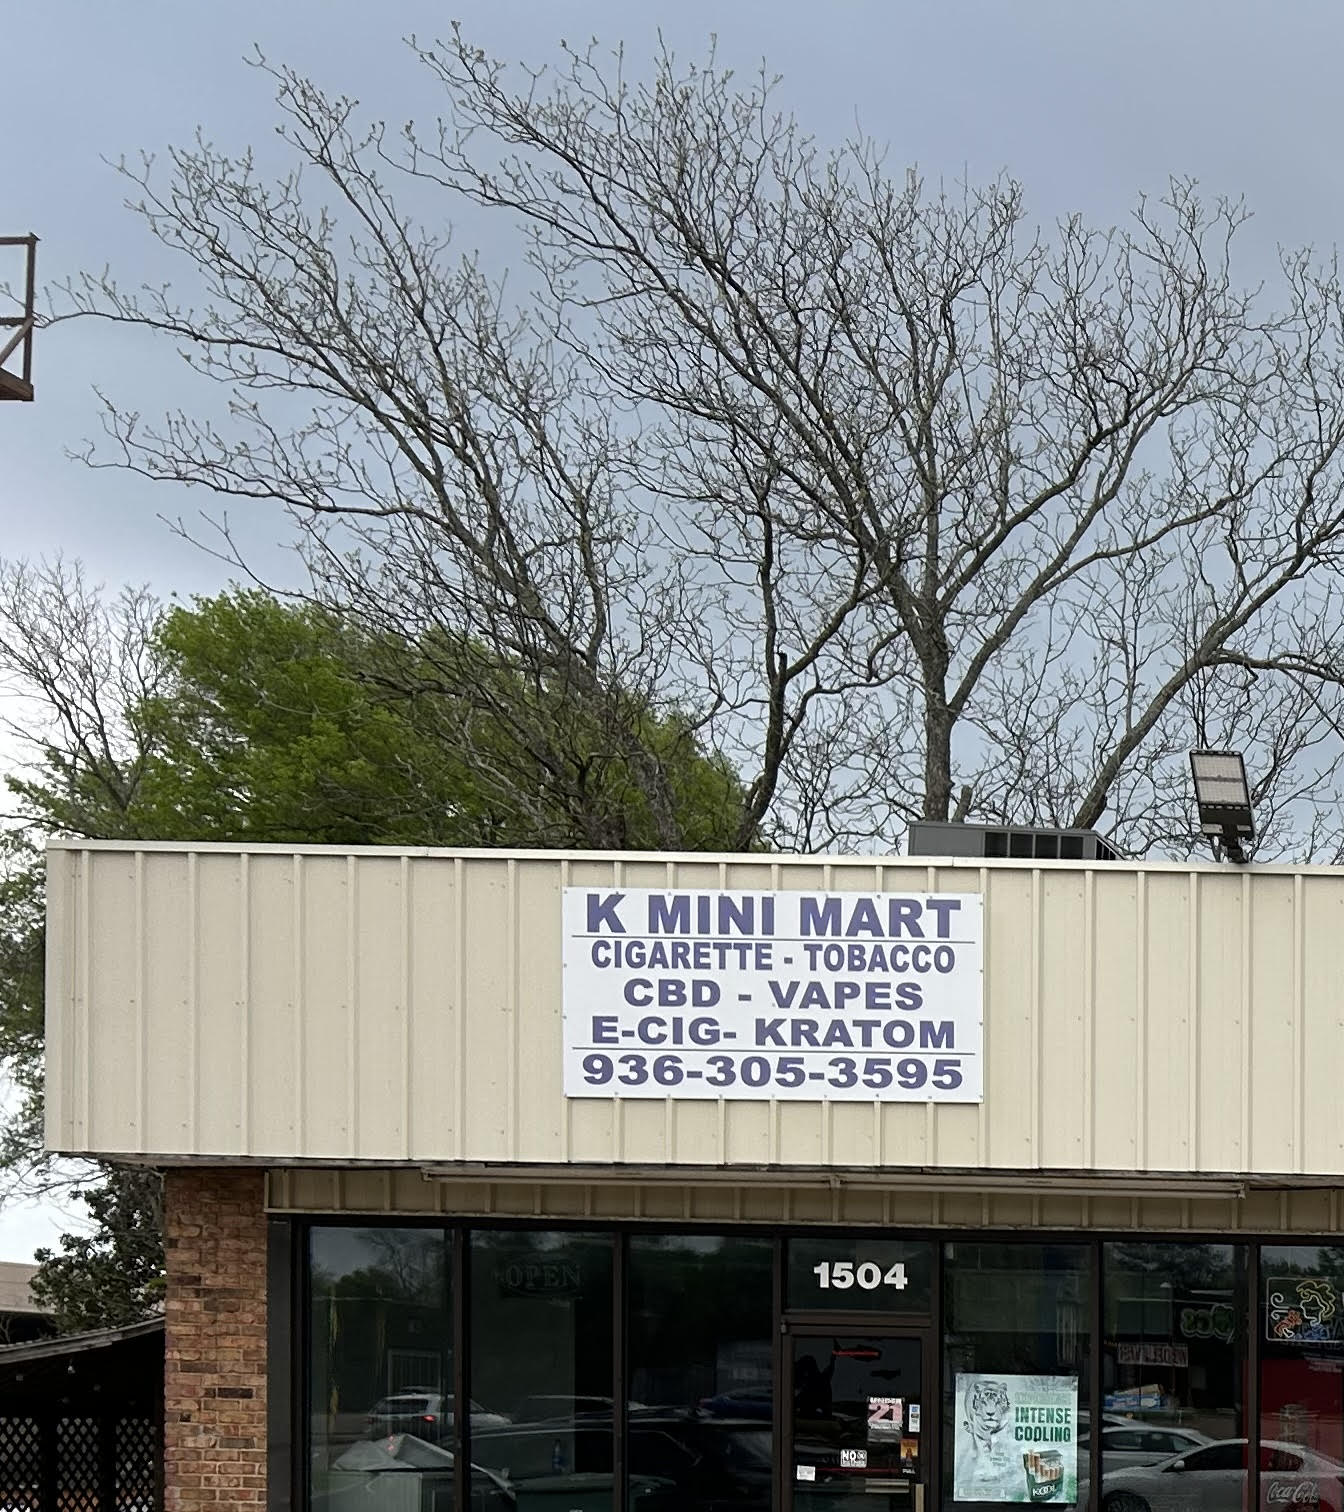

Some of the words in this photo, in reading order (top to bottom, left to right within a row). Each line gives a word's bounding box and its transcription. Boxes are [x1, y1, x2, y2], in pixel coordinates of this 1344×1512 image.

[586, 893, 627, 934] K
[647, 894, 775, 936] MINI
[799, 897, 962, 939] MART
[590, 940, 773, 970] CIGARETTE
[803, 943, 956, 974] TOBACCO
[623, 978, 722, 1008] CBD
[767, 980, 924, 1011] VAPES
[754, 1018, 956, 1049] KRATOM
[581, 1054, 964, 1090] 936-305-3595
[813, 1261, 909, 1290] 1504
[868, 1403, 904, 1424] 21
[1015, 1406, 1072, 1424] INTENSE
[1015, 1426, 1071, 1443] COOLING
